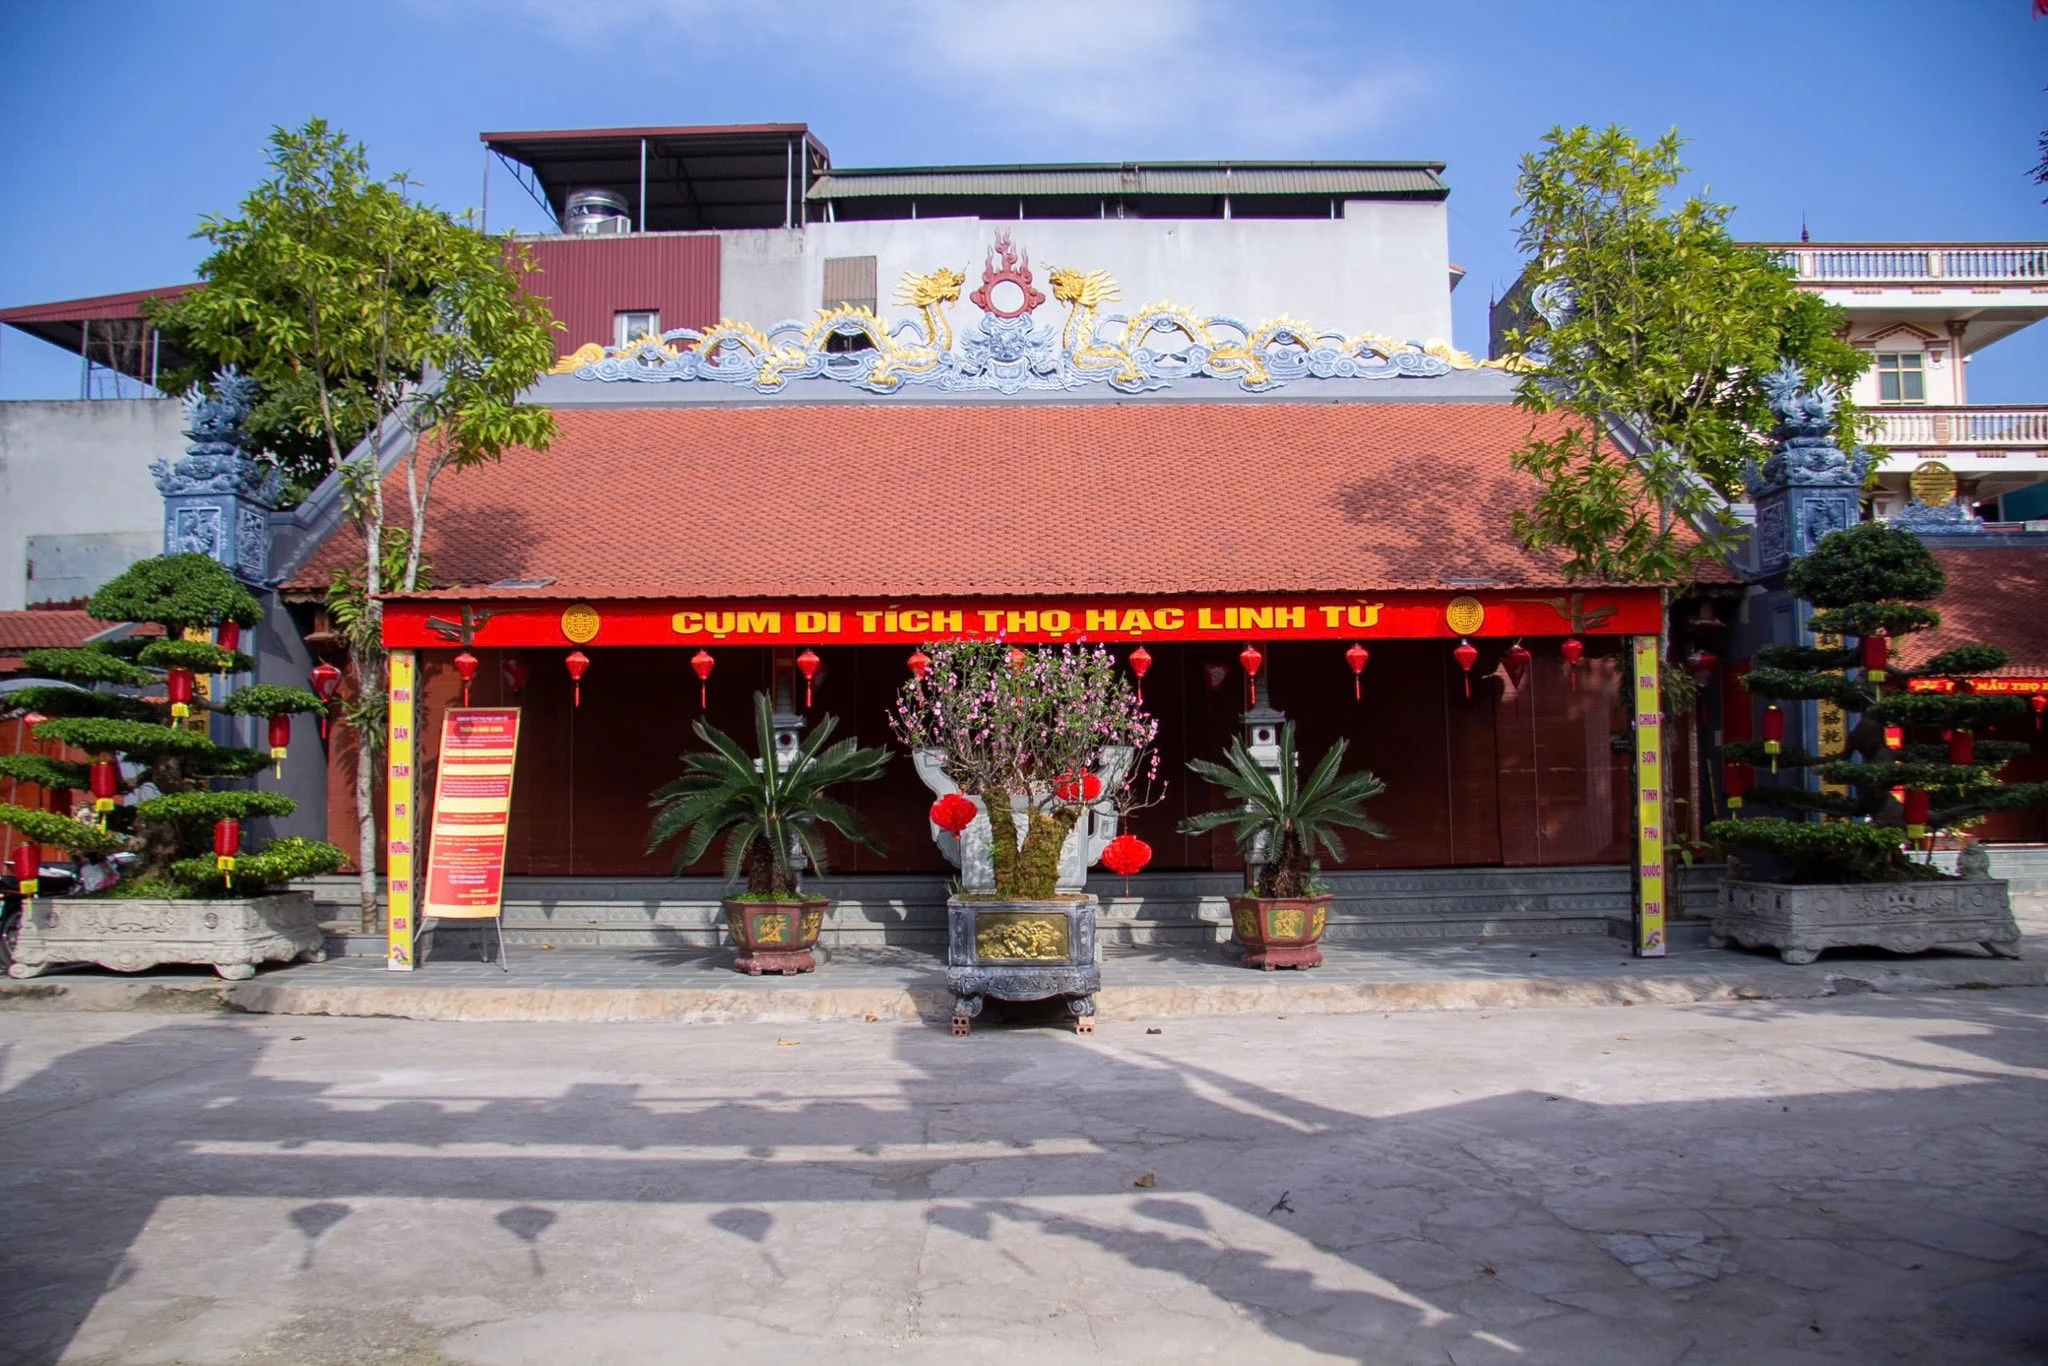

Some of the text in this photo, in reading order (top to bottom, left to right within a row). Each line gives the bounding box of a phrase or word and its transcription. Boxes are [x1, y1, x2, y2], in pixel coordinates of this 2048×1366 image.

[672, 599, 1384, 639] CỤM DI TÍCH THỌ HẠC LINH TỪ
